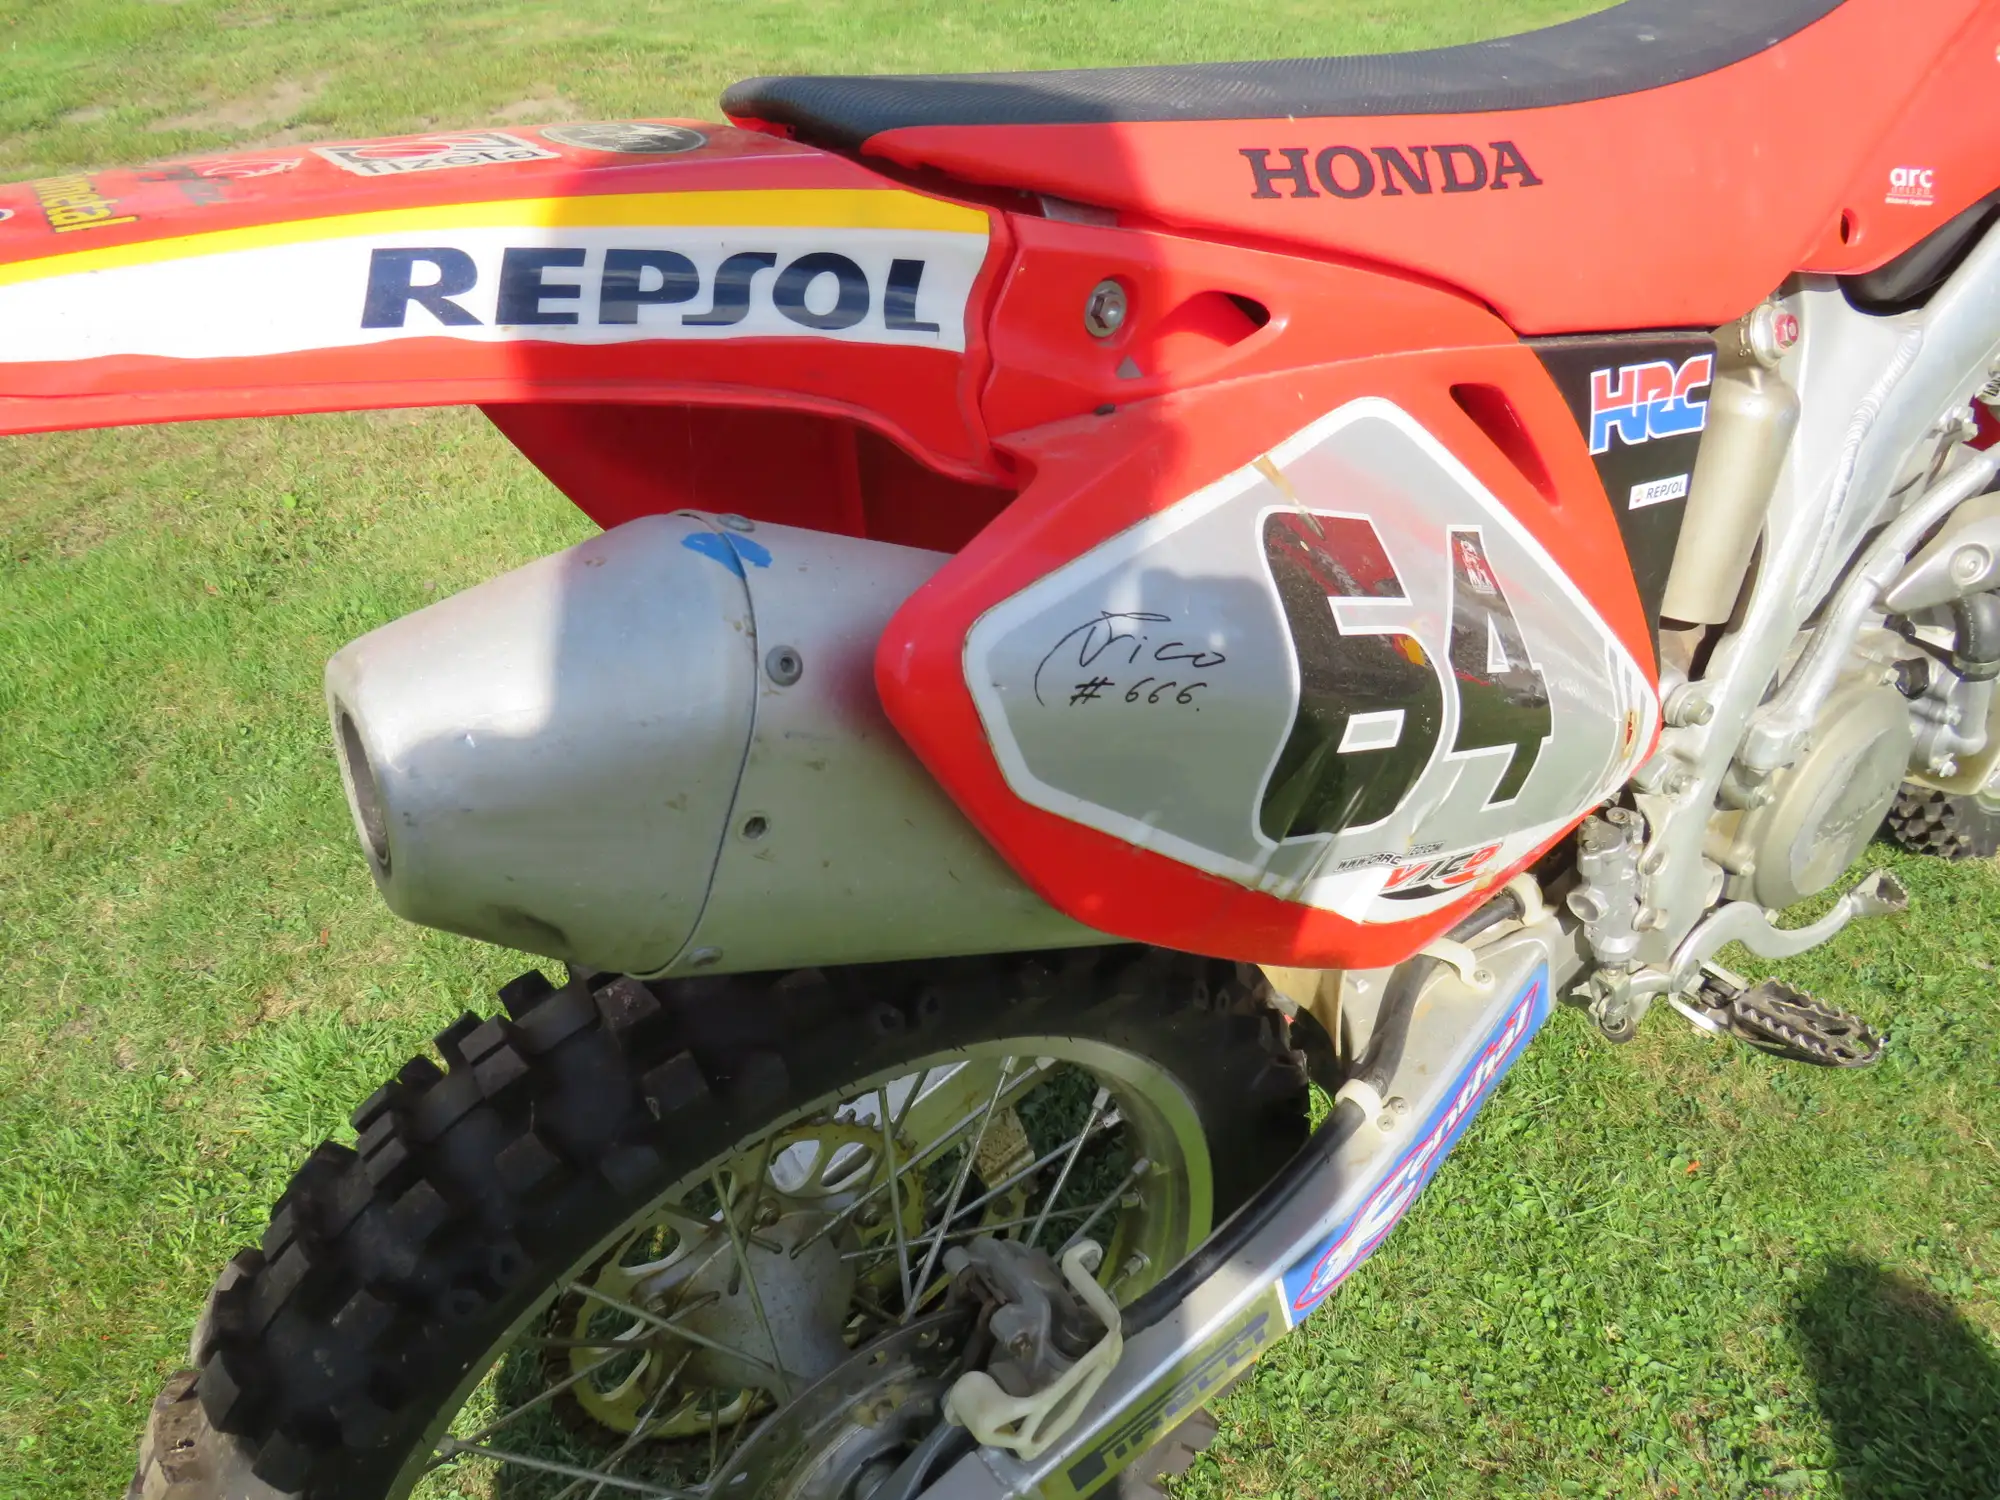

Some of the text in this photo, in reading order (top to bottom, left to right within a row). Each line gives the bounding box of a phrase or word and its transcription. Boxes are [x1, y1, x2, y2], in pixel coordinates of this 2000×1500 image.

[360, 149, 541, 174] fizeta
[1238, 141, 1544, 200] HONDA
[1889, 167, 1934, 188] arc
[361, 247, 940, 333] REPSOL
[1588, 353, 1713, 456] HRC
[1645, 481, 1684, 500] REPSOL
[1252, 504, 1554, 850] 64
[1066, 1311, 1270, 1491] PIRELLI
